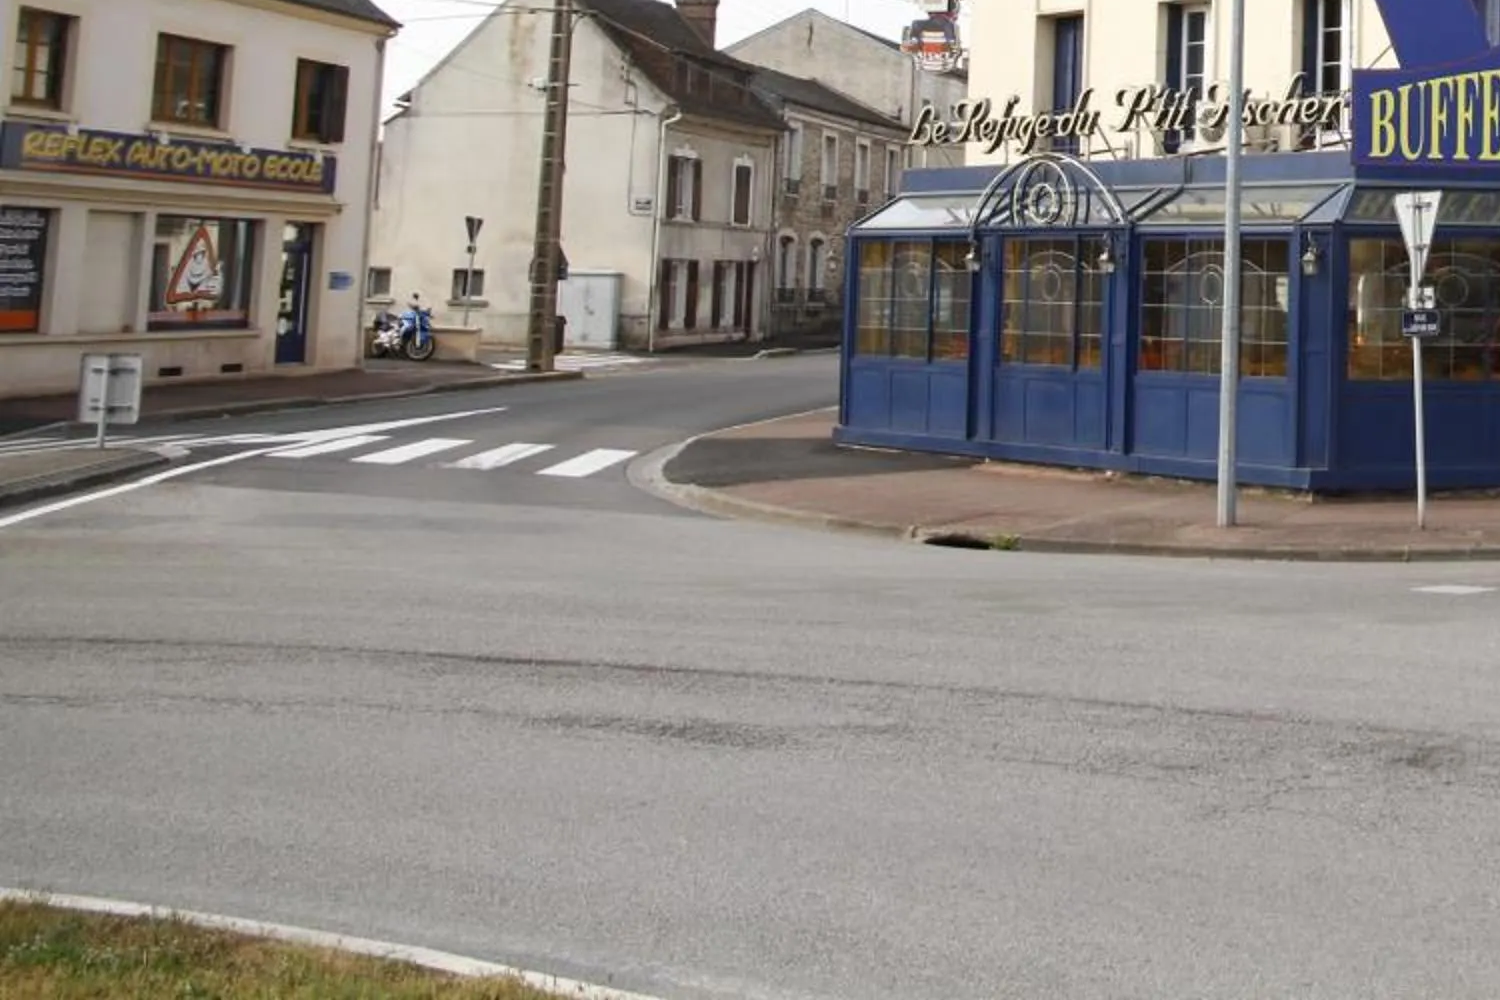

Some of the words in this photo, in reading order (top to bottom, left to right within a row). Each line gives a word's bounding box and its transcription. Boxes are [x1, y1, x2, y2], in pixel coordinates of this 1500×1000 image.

[908, 103, 949, 146] Le
[952, 95, 1051, 155] Refuge
[1056, 87, 1101, 137] du
[1200, 71, 1345, 128] Fscher
[22, 131, 123, 166] REFLEX
[126, 139, 259, 178] AUTO-MOTO
[263, 154, 323, 183] ECOLE
